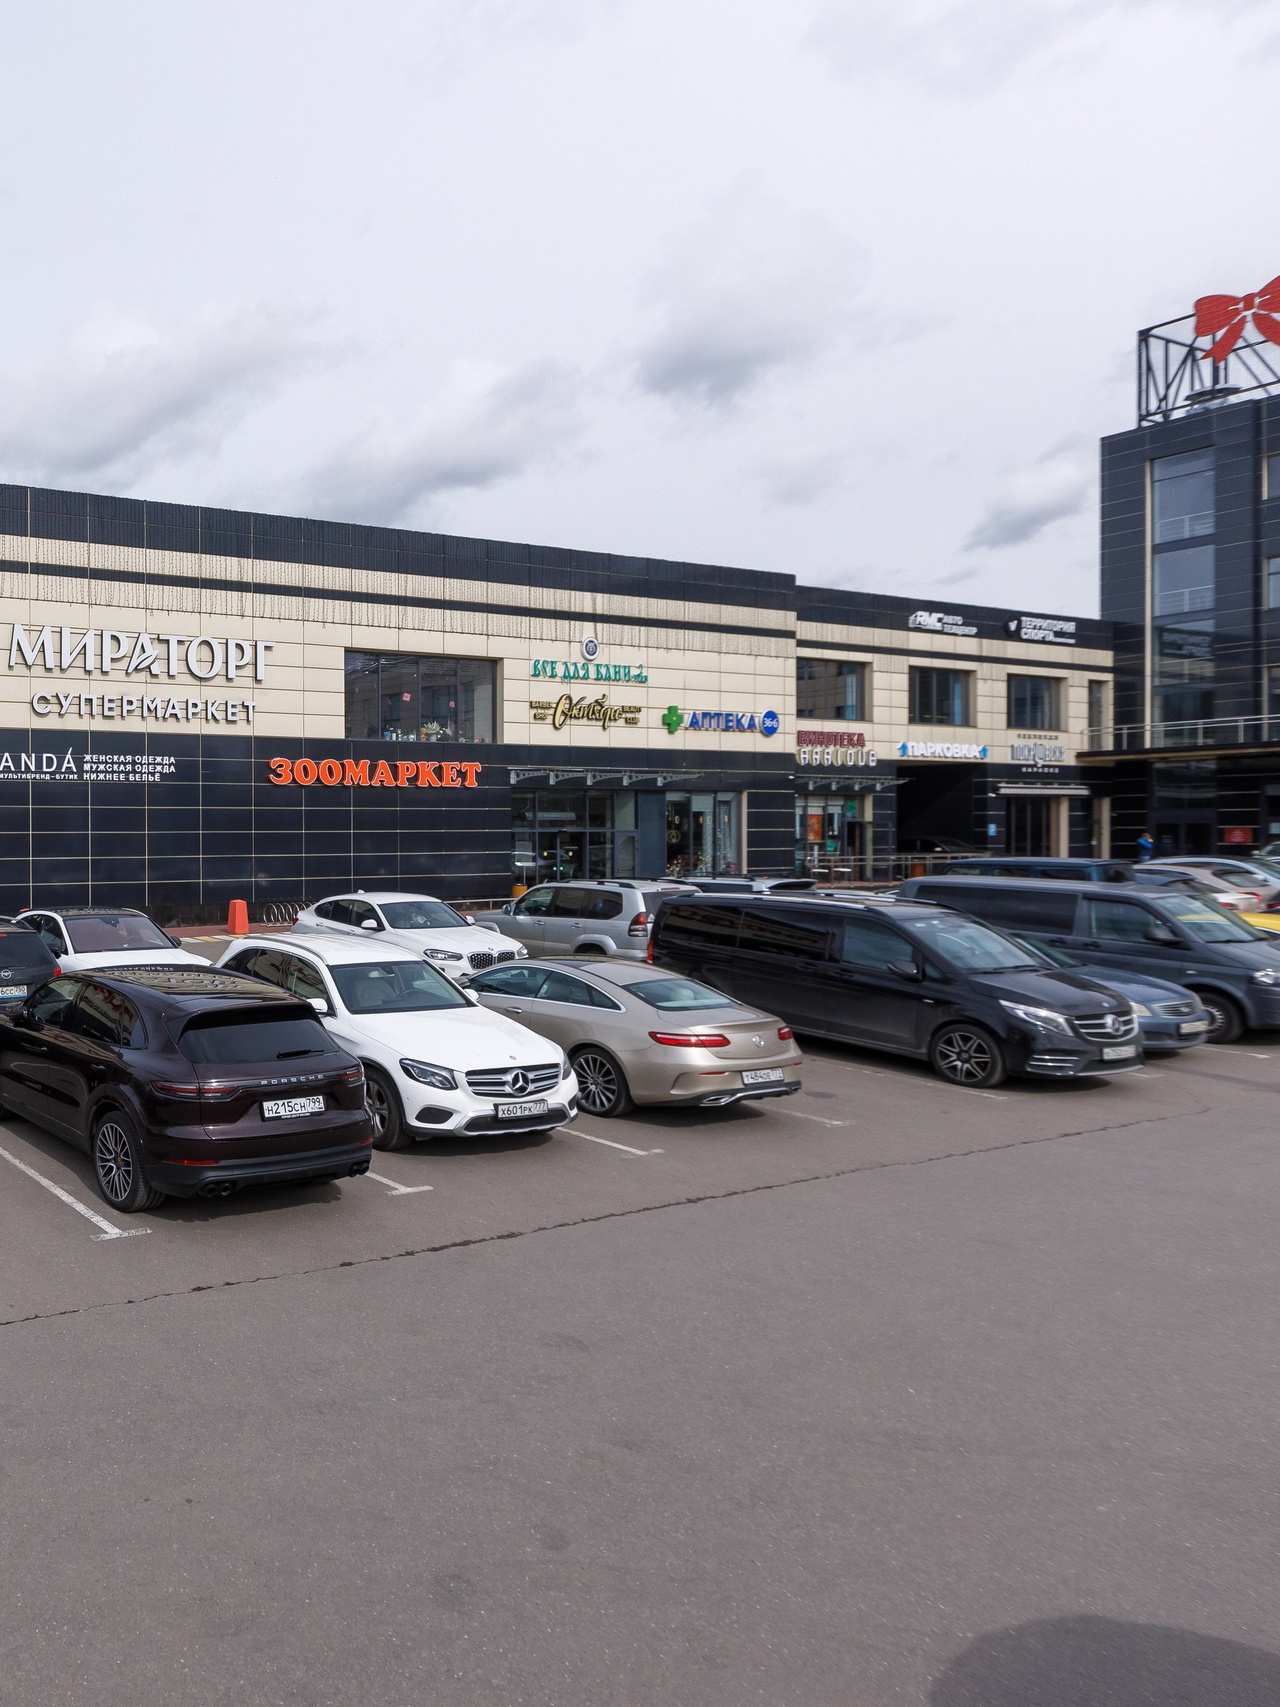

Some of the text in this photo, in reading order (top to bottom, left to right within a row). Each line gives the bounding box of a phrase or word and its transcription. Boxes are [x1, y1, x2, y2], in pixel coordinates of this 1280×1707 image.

[1021, 616, 1076, 633] ТЕРРИТОРИЯ
[1021, 628, 1054, 640] СПОРТА
[9, 623, 275, 681] МИРАТОРГ
[531, 659, 632, 684] ВСЕ ДЛЯ БАНИ
[32, 691, 257, 722] СУПЕРМАРКЕТ
[687, 711, 758, 731] АПТЕКА
[798, 730, 867, 748] ВИНОТЕКА
[908, 741, 981, 758] ПАРКОВКА
[0, 747, 77, 772] ANDÁ
[83, 754, 176, 764] ЖЕНСКАЯ ОДЕЖДА
[83, 764, 176, 773] МУЖСКАЯ ОДЕЖДА
[269, 757, 482, 788] ЗООМАРКЕТ
[83, 773, 161, 782] НИЖНЕЕ БЕЛЬЁ
[261, 1075, 324, 1085] PORSCHE
[267, 1097, 321, 1115] Н215СН 799
[501, 1102, 546, 1116] Х601РК 777
